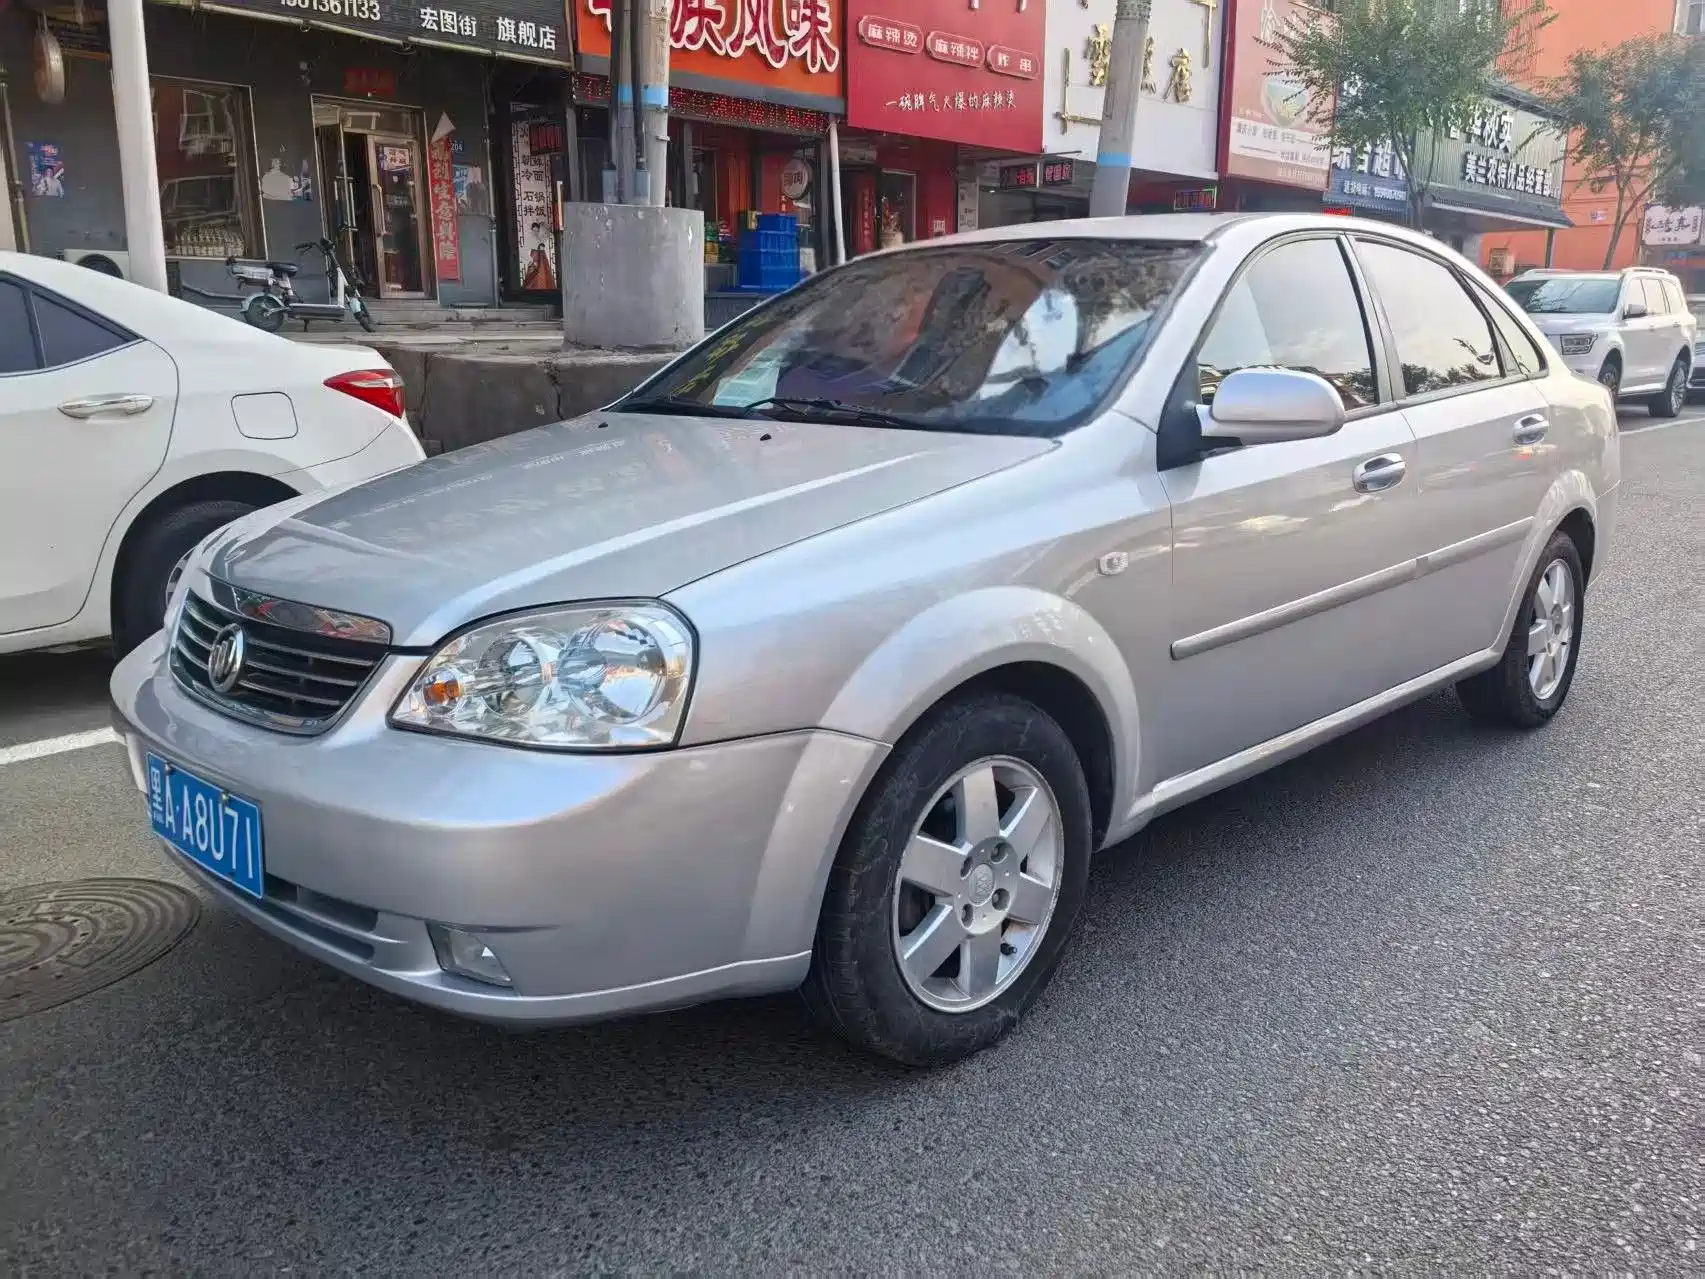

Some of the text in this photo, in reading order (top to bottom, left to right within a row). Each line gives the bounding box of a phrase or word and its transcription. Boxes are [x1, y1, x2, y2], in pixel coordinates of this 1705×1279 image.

[419, 7, 477, 37] 宏图街
[496, 17, 556, 50] 旗舰店
[867, 23, 918, 48] 麻辣烫
[935, 38, 979, 61] 麻辣拌
[883, 89, 1017, 112] 一碗脾气火爆的麻辣烫
[521, 168, 544, 181] 冷面
[523, 190, 546, 203] 石锅
[523, 204, 546, 217] 拌饭
